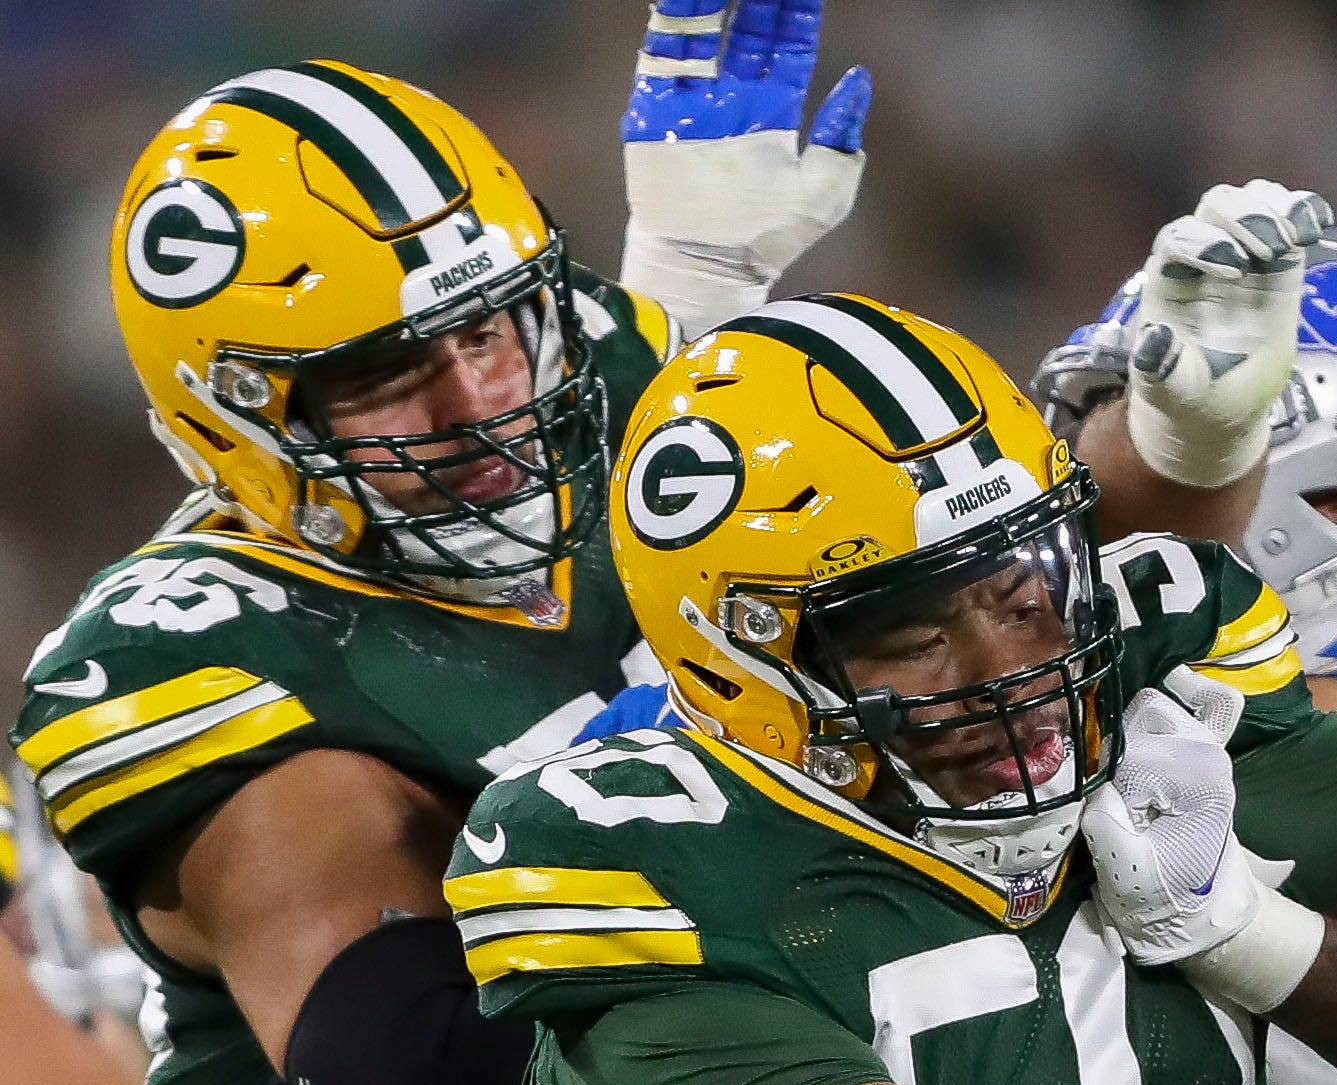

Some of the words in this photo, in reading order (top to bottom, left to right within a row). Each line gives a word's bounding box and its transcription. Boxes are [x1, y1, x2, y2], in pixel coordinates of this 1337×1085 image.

[430, 250, 493, 296] PACKERS
[627, 425, 737, 540] G
[945, 474, 1012, 520] PACKERS
[815, 547, 884, 577] OAKLEY
